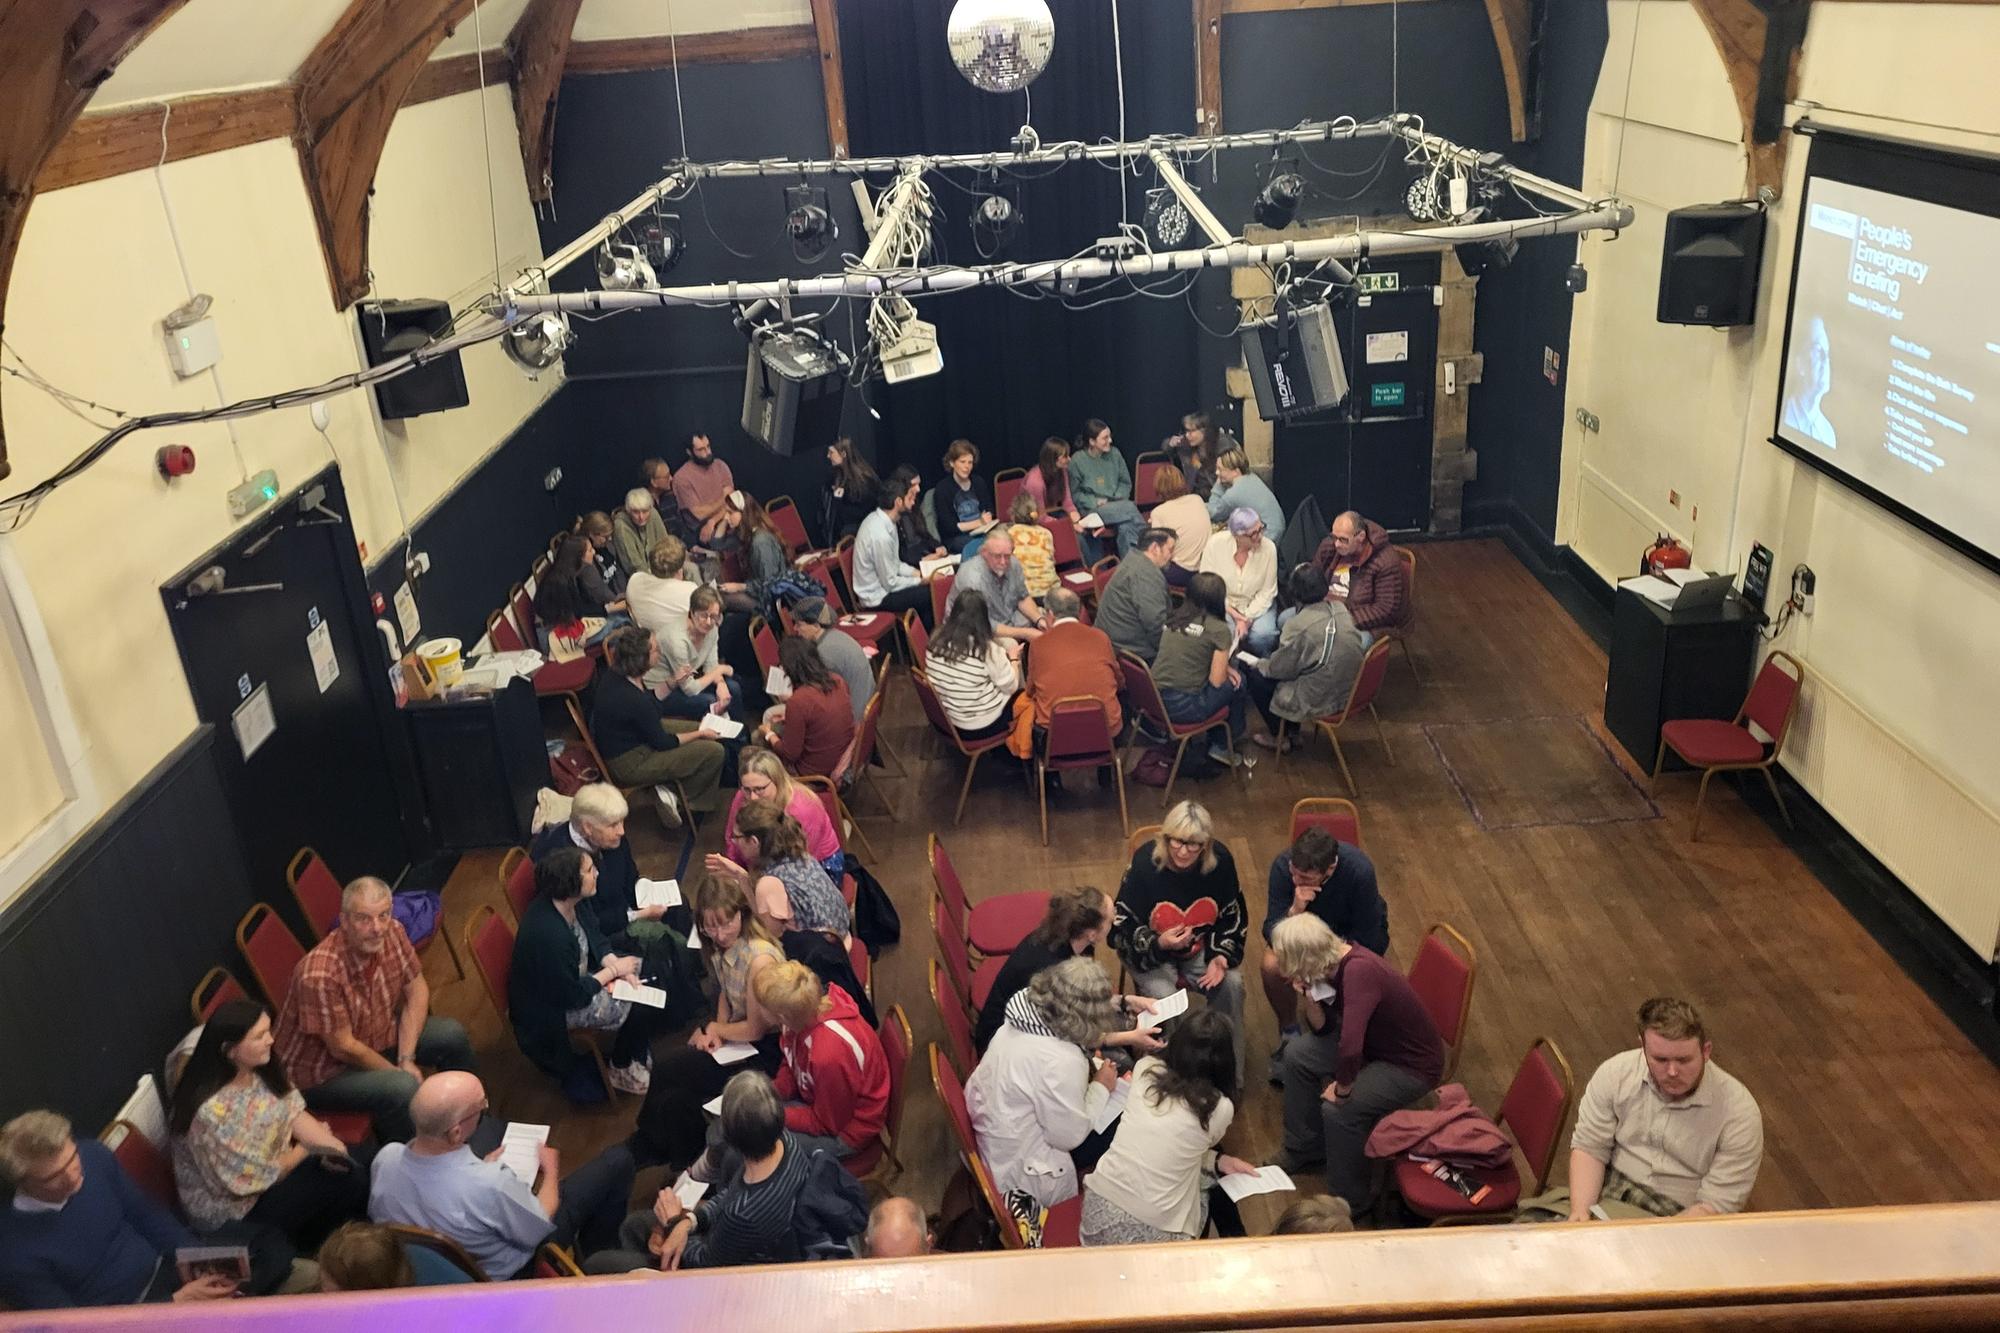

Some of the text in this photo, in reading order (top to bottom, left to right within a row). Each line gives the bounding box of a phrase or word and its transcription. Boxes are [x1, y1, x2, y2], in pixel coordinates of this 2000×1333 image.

[1860, 216, 1912, 251] People's
[1856, 239, 1929, 285] Emergency
[1852, 263, 1900, 302] Briefing
[1375, 387, 1390, 395] Push
